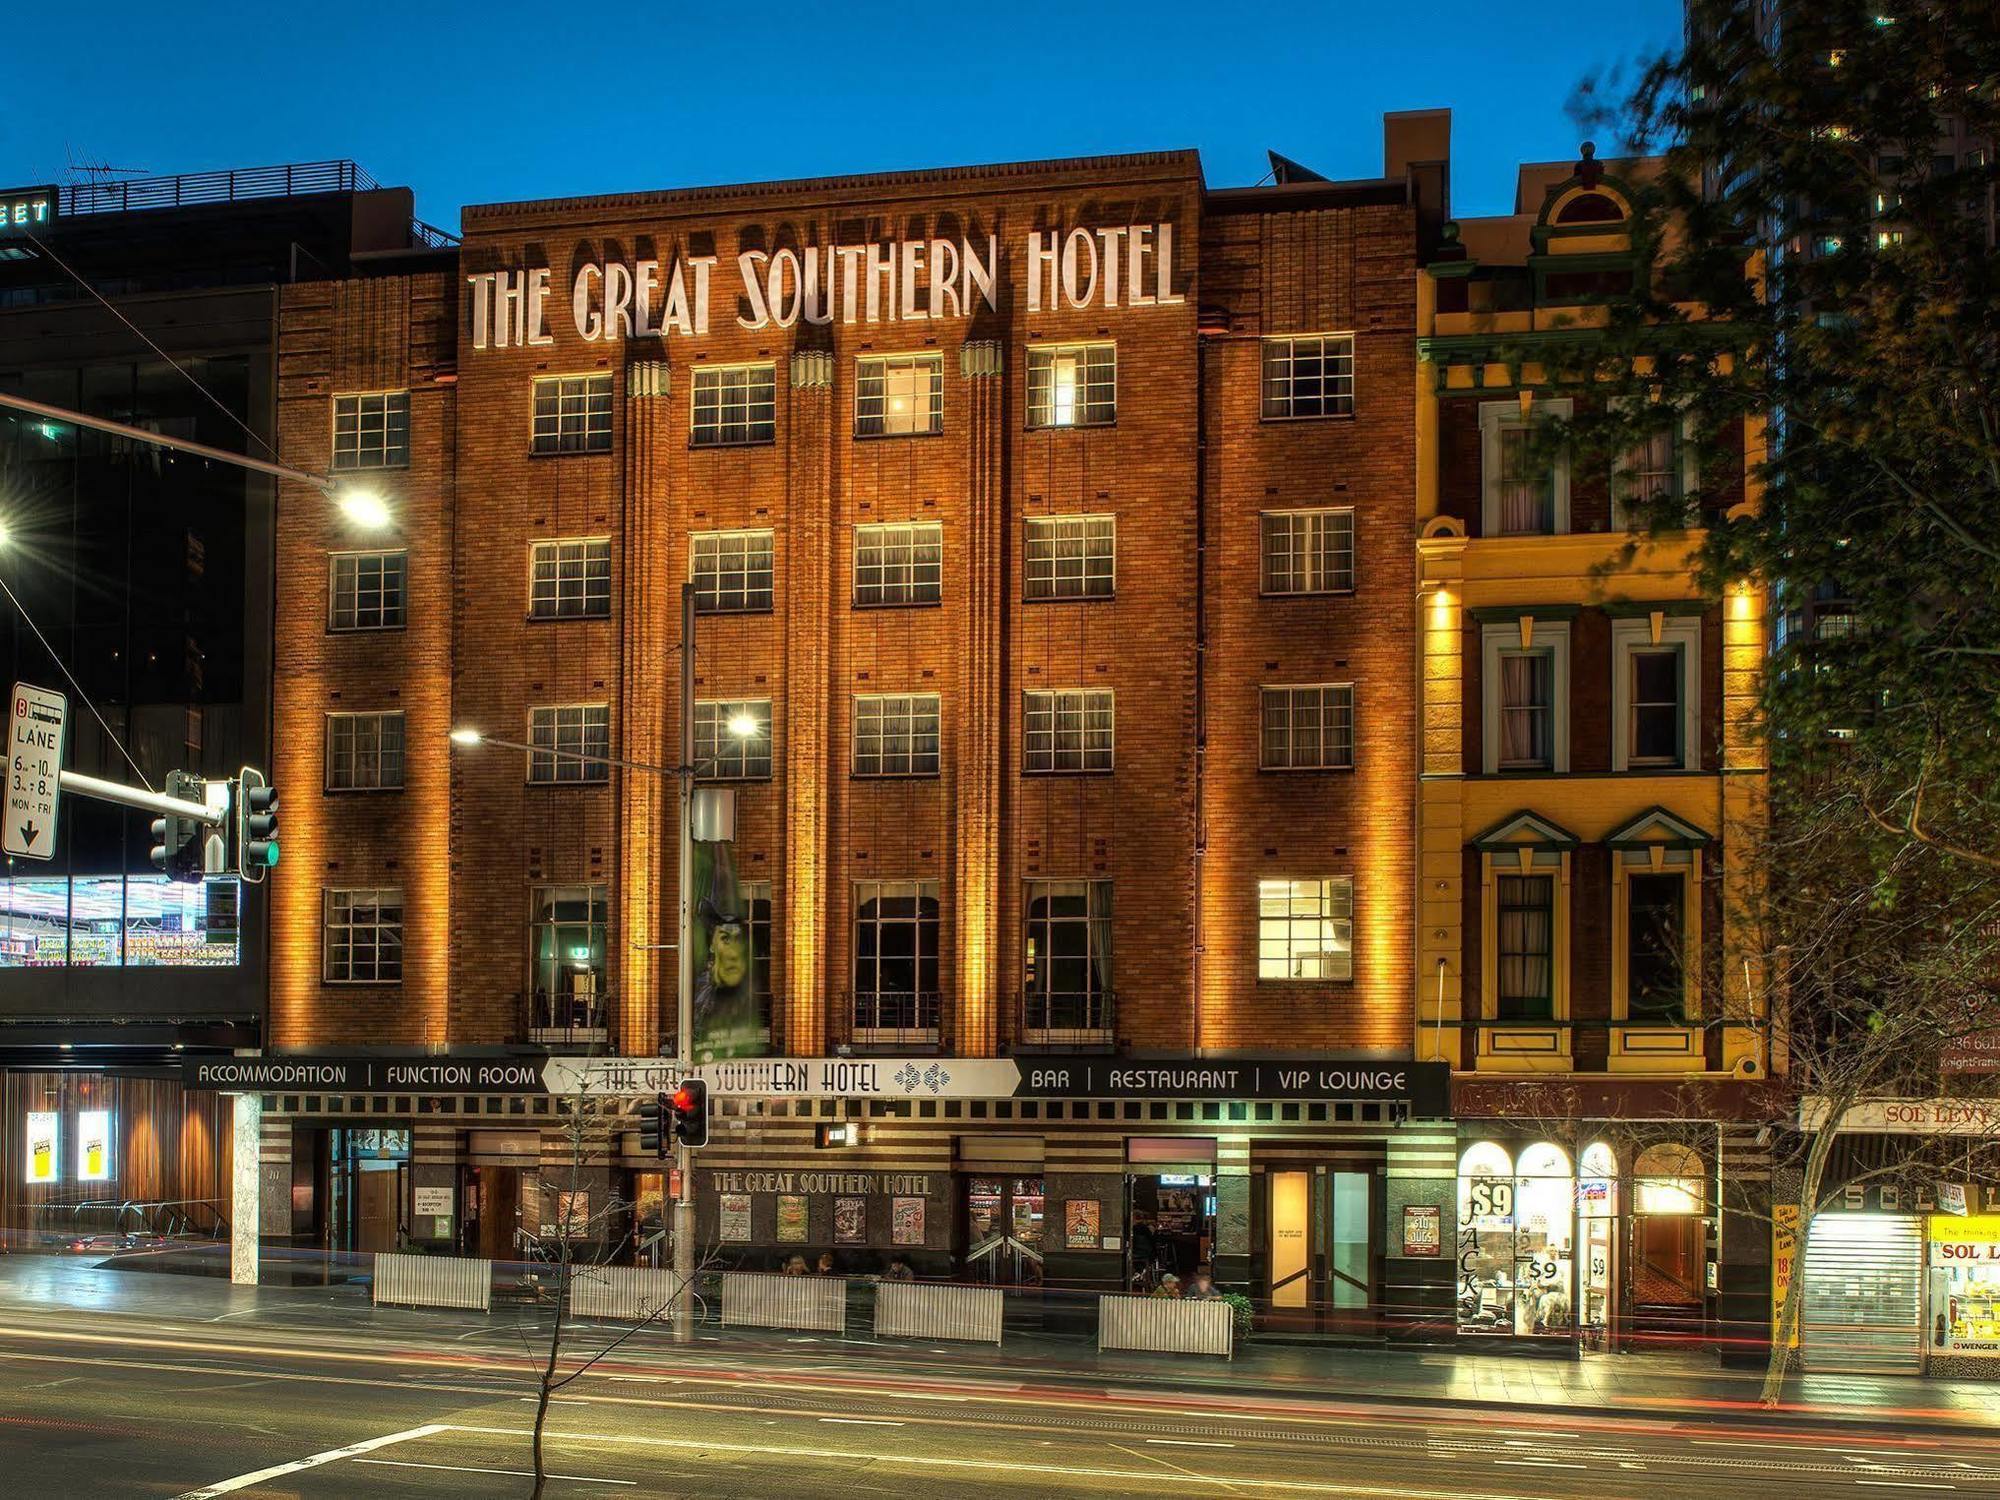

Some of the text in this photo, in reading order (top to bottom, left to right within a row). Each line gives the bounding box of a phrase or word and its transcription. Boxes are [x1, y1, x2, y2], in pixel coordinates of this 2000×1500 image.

[467, 223, 1185, 349] THE GREAT SOUTHERN HOTEL
[17, 726, 56, 750] LANE
[12, 798, 29, 811] MON
[38, 803, 51, 815] FRI
[199, 1065, 536, 1085] ACCOMMODATION FUNCTION ROOM
[604, 1062, 637, 1090] THE
[715, 1063, 808, 1091] SOUTHERN
[821, 1063, 880, 1091] HOTEL
[1031, 1069, 1406, 1091] BAR RESTAURANT VIP LOUNGE
[1886, 1105, 1989, 1123] SOL LEVY
[713, 1172, 932, 1195] THE GREAT SOUTHERN HOTEL
[1471, 1182, 1512, 1217] $9
[1942, 1244, 1980, 1259] SOL
[1529, 1260, 1557, 1281] $9
[1592, 1258, 1605, 1276] $9
